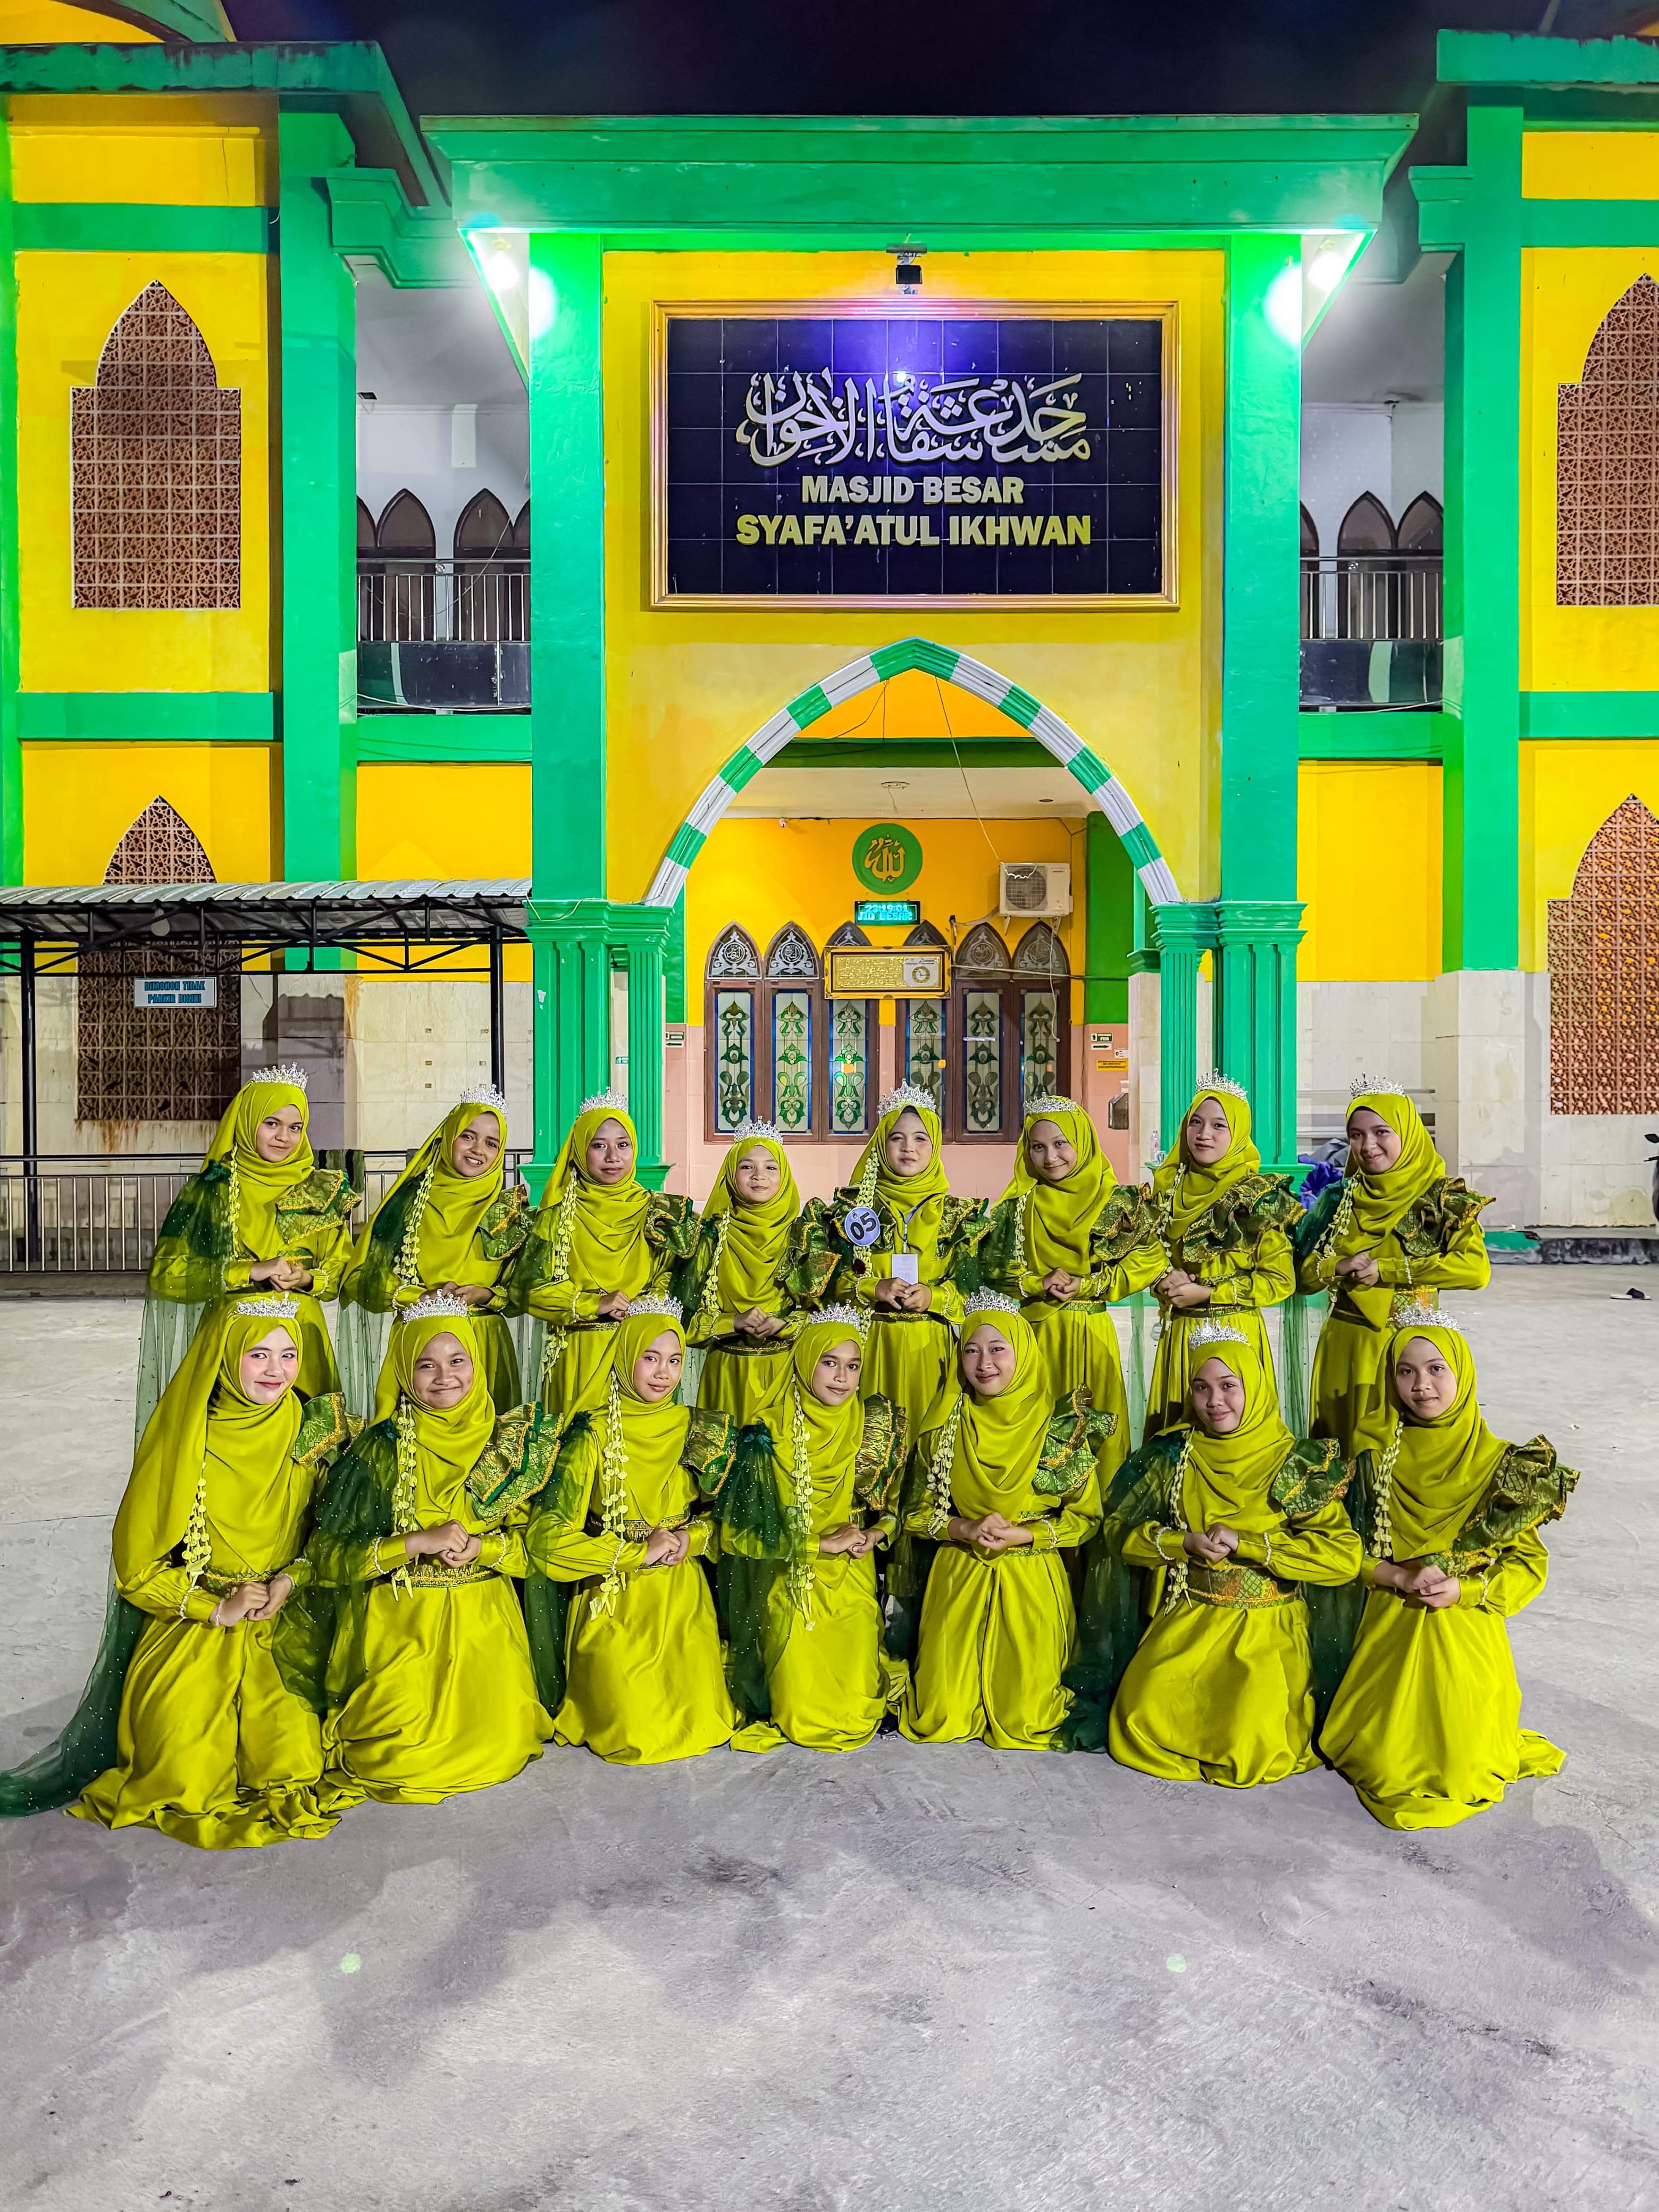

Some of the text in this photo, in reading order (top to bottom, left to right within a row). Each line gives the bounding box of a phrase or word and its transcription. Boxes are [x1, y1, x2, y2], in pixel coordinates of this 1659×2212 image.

[802, 475, 1025, 505] MASJID BESAR
[736, 515, 1092, 546] SYAFA'ATUL IKHWAN
[182, 981, 205, 990] TIDAK
[850, 1211, 877, 1240] 05
